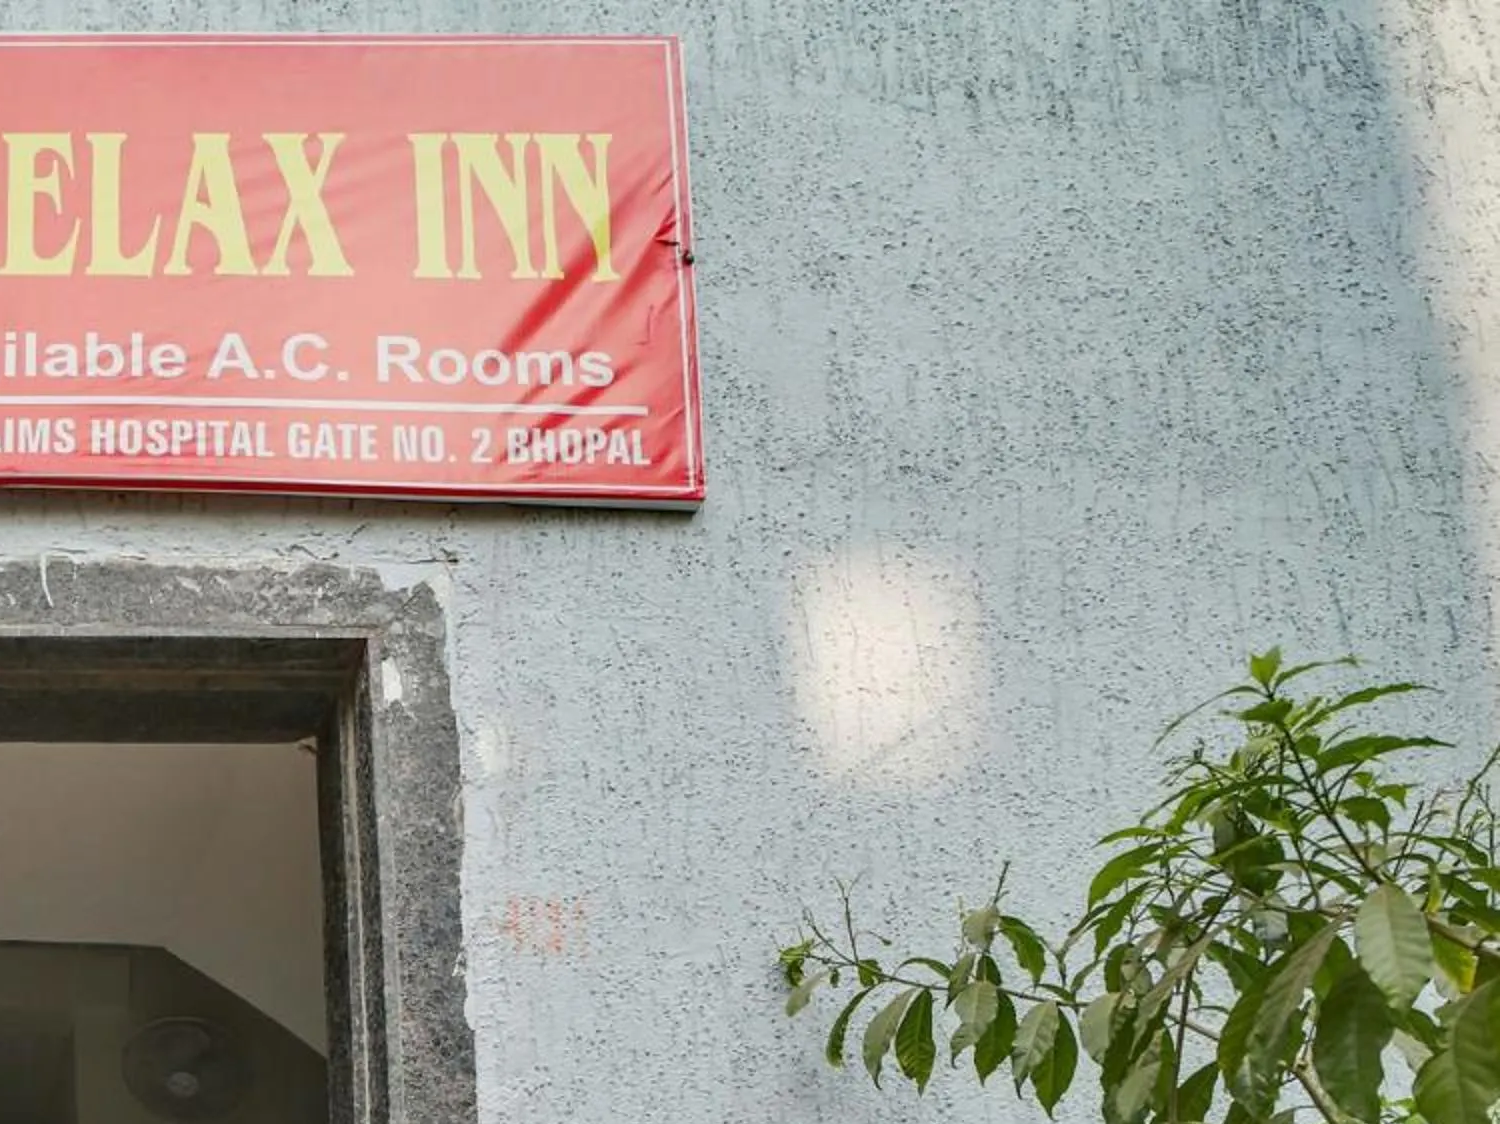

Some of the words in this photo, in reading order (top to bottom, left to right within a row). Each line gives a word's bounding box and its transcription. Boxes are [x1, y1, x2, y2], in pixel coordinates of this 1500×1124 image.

[407, 132, 621, 283] INN
[206, 333, 350, 381] A.C.
[376, 335, 615, 388] Rooms
[90, 419, 275, 459] HOSPITAL
[287, 422, 377, 461] GATE
[392, 425, 455, 464] NO.
[471, 427, 493, 464] 2
[506, 426, 652, 467] BHOPAL
